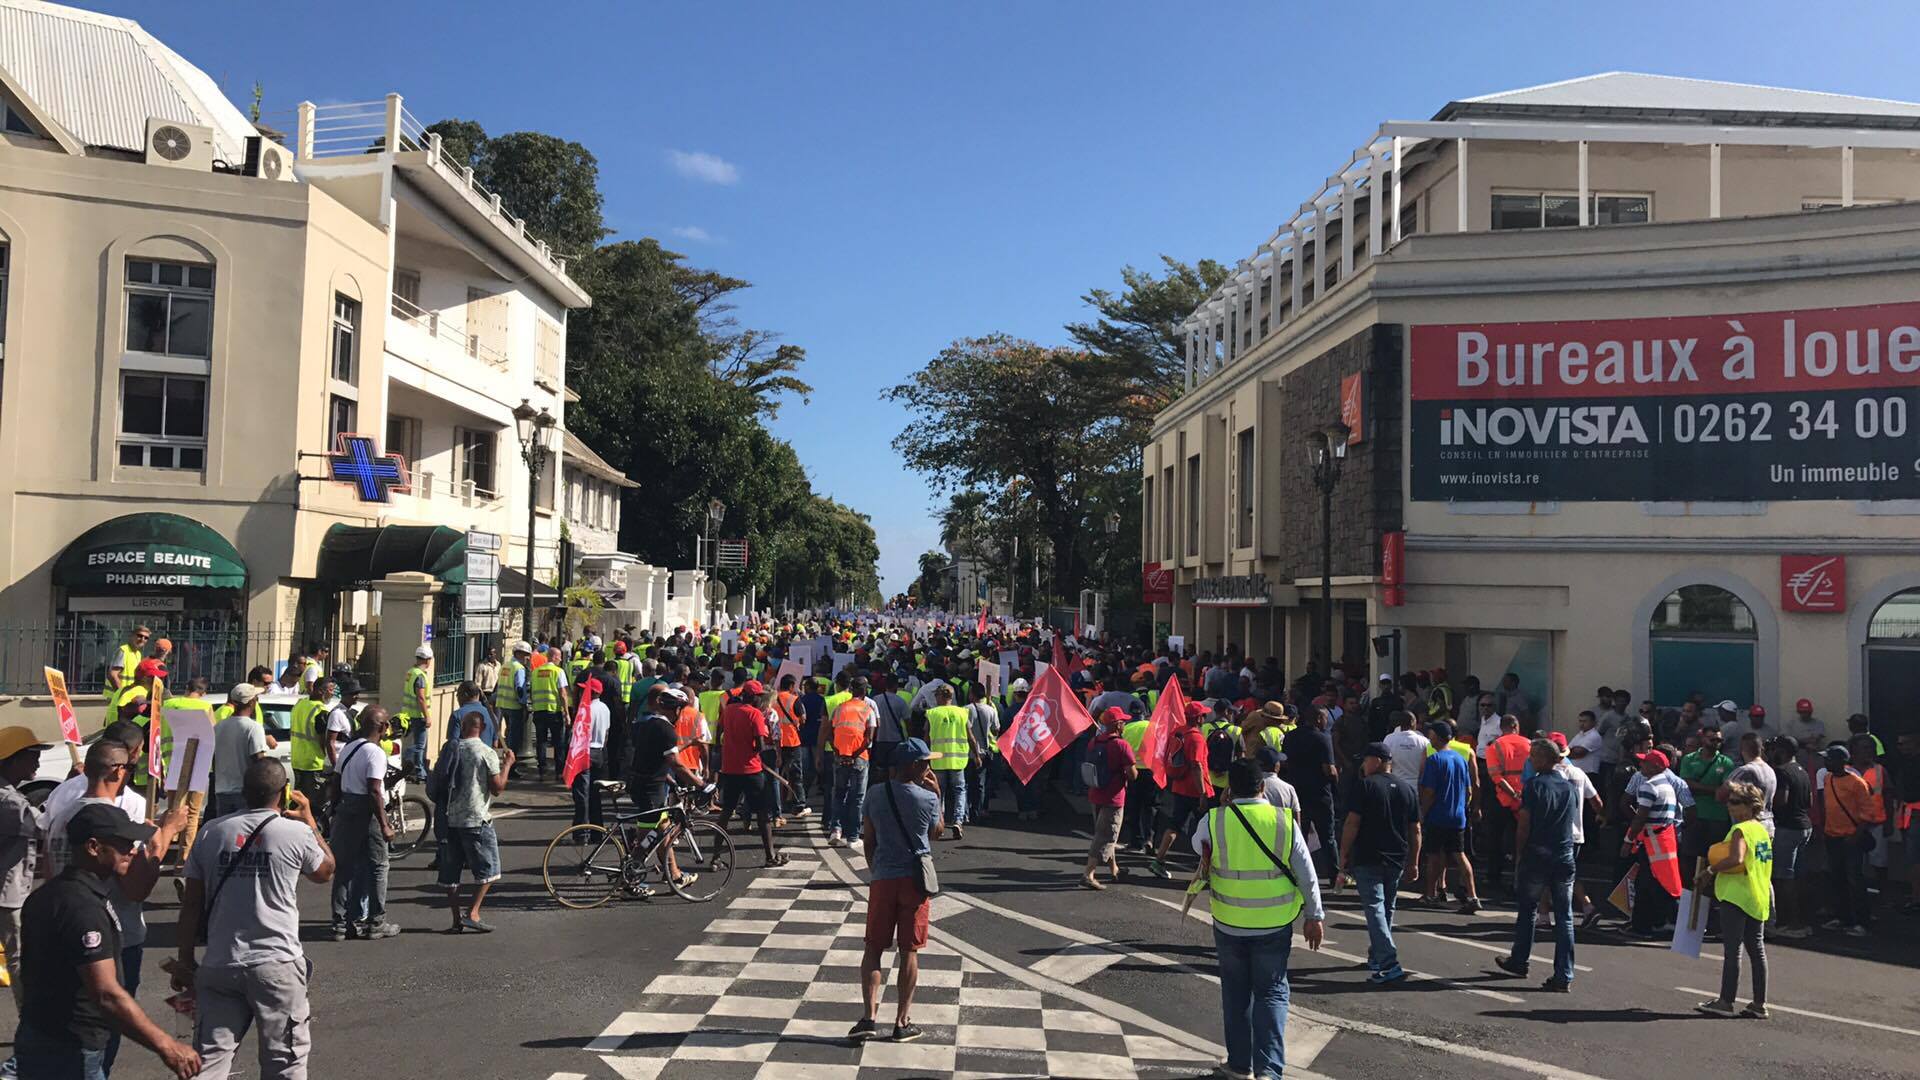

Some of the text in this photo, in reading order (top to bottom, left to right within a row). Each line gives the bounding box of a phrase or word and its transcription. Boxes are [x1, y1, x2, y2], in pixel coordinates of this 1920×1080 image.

[1458, 319, 1920, 386] Bureaux à loue
[1674, 402, 1772, 443] 0262
[1789, 400, 1838, 440] 34
[1855, 397, 1906, 438] 00
[1440, 449, 1649, 460] CONSEIL EN IMMOBILIER D'ENTREPRISE
[1440, 472, 1539, 484] www.inovista.re
[1770, 462, 1899, 482] Un immeuble
[88, 552, 211, 568] ESPACE BEAUTE
[106, 574, 190, 585] PHARMACIE
[132, 598, 173, 606] LIERAC
